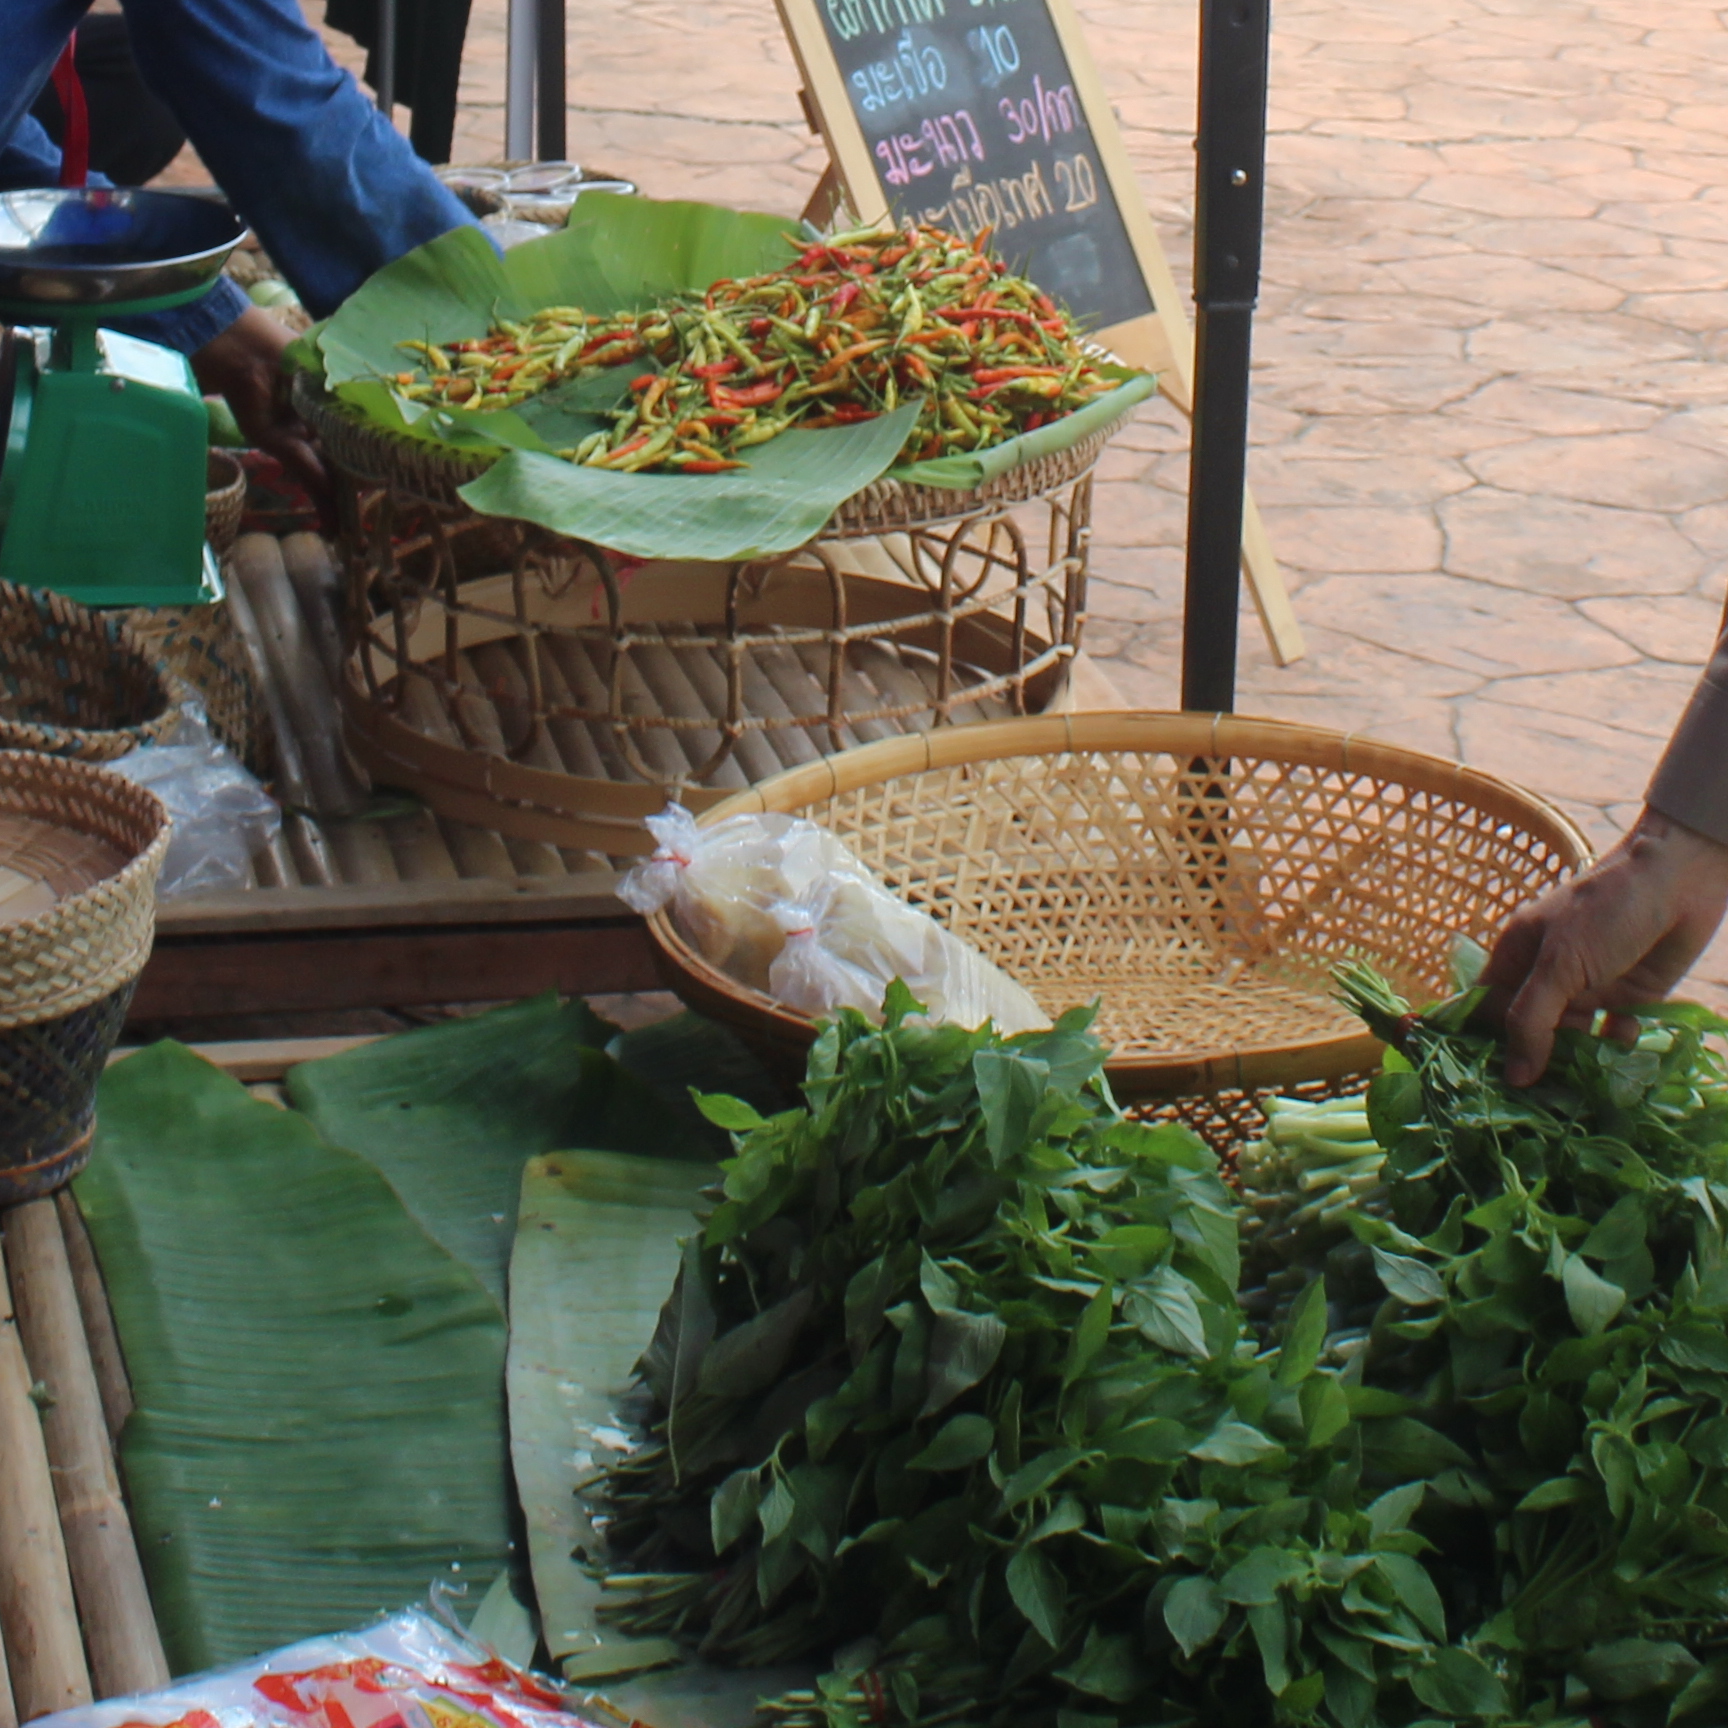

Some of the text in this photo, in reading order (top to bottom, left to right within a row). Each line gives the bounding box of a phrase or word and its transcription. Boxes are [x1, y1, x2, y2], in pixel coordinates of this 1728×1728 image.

[979, 24, 1021, 75] 10
[875, 109, 985, 186] มะนาว
[1053, 153, 1099, 213] 20
